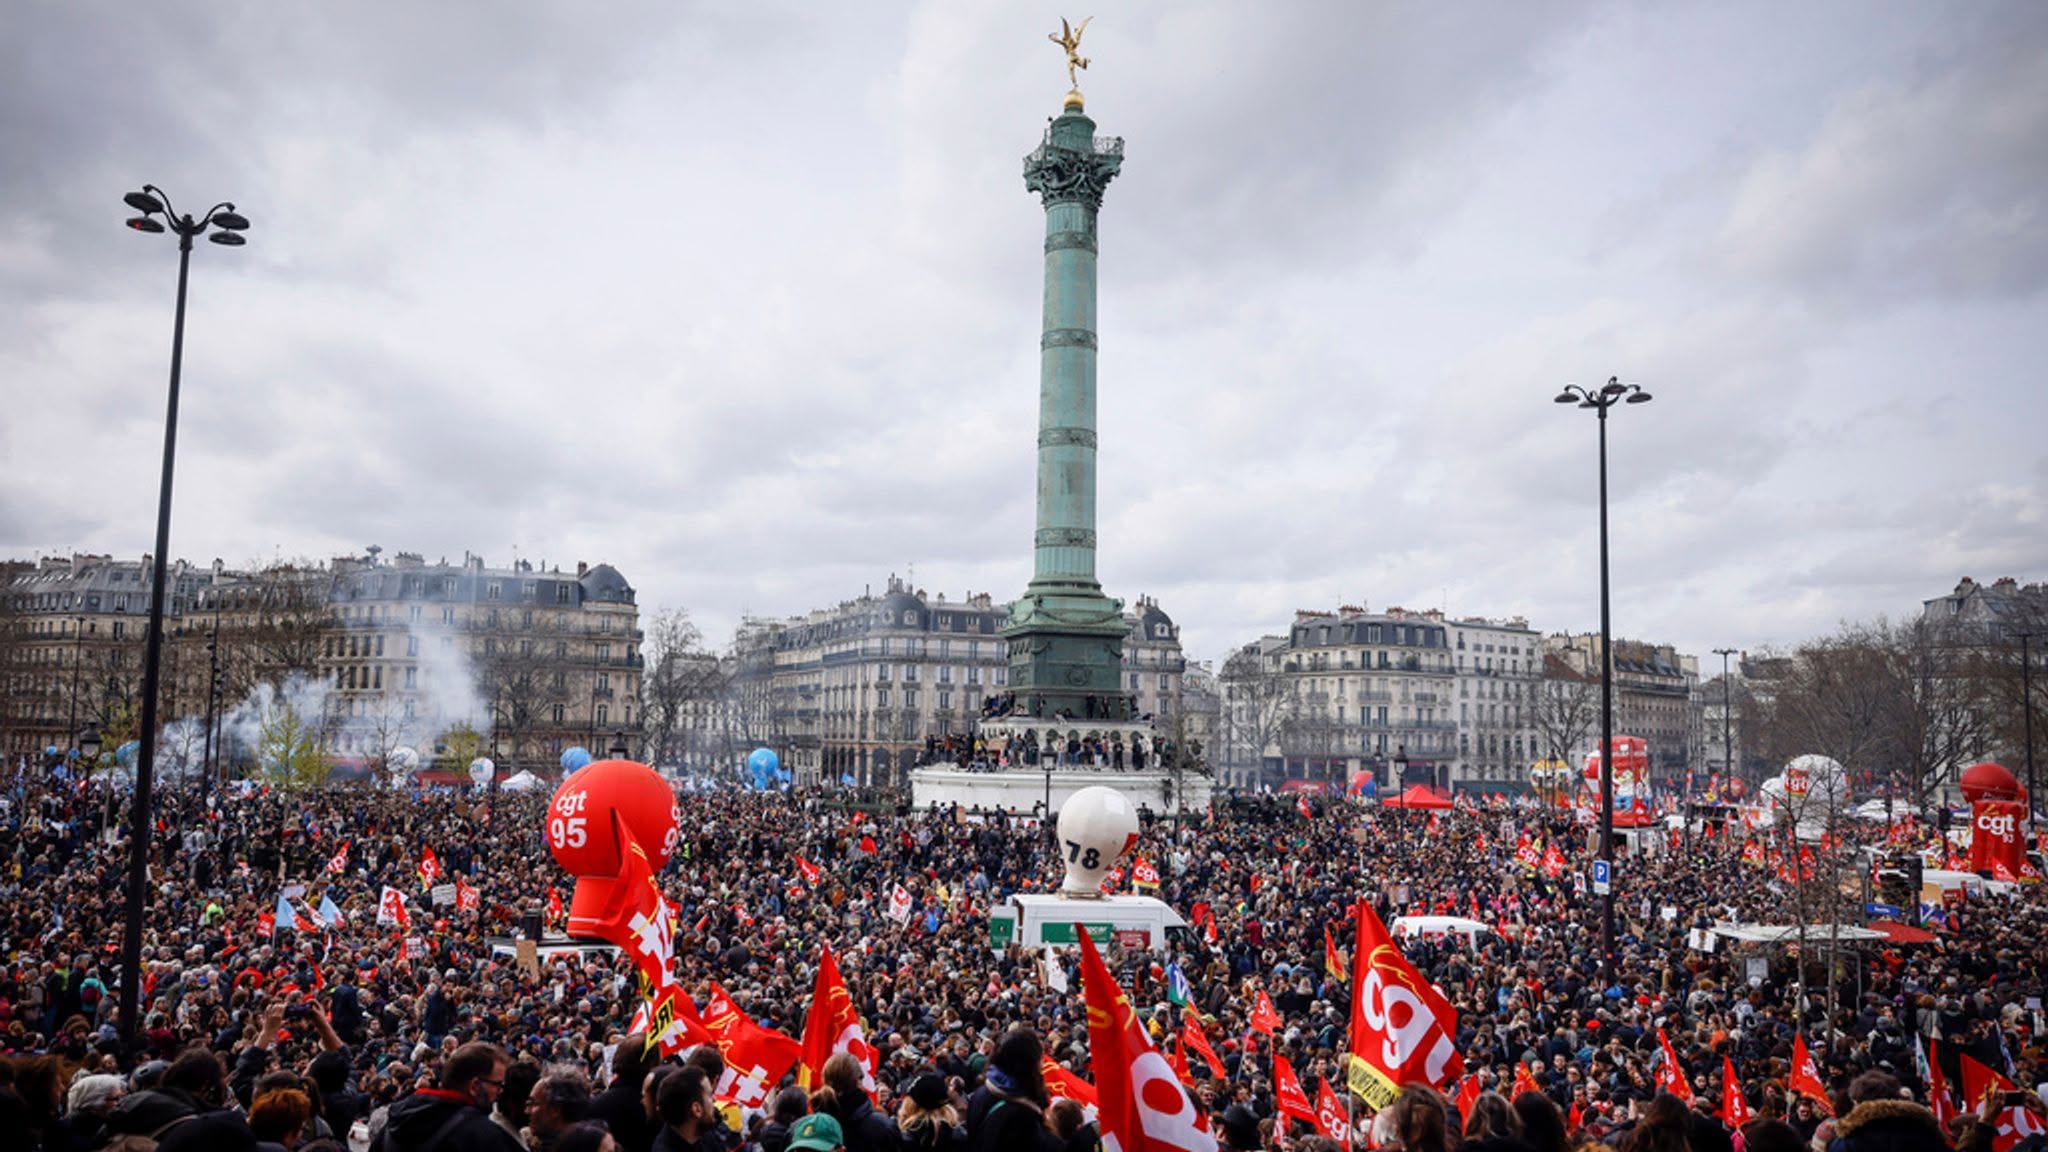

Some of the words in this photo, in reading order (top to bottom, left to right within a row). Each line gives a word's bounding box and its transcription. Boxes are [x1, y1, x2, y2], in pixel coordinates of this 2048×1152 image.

[556, 790, 587, 817] cgt
[551, 818, 587, 849] 95
[1977, 814, 2014, 835] cgt
[1066, 839, 1100, 869] 78
[1598, 866, 1605, 876] P
[1362, 967, 1455, 1085] cgt
[1320, 1109, 1349, 1141] cg
